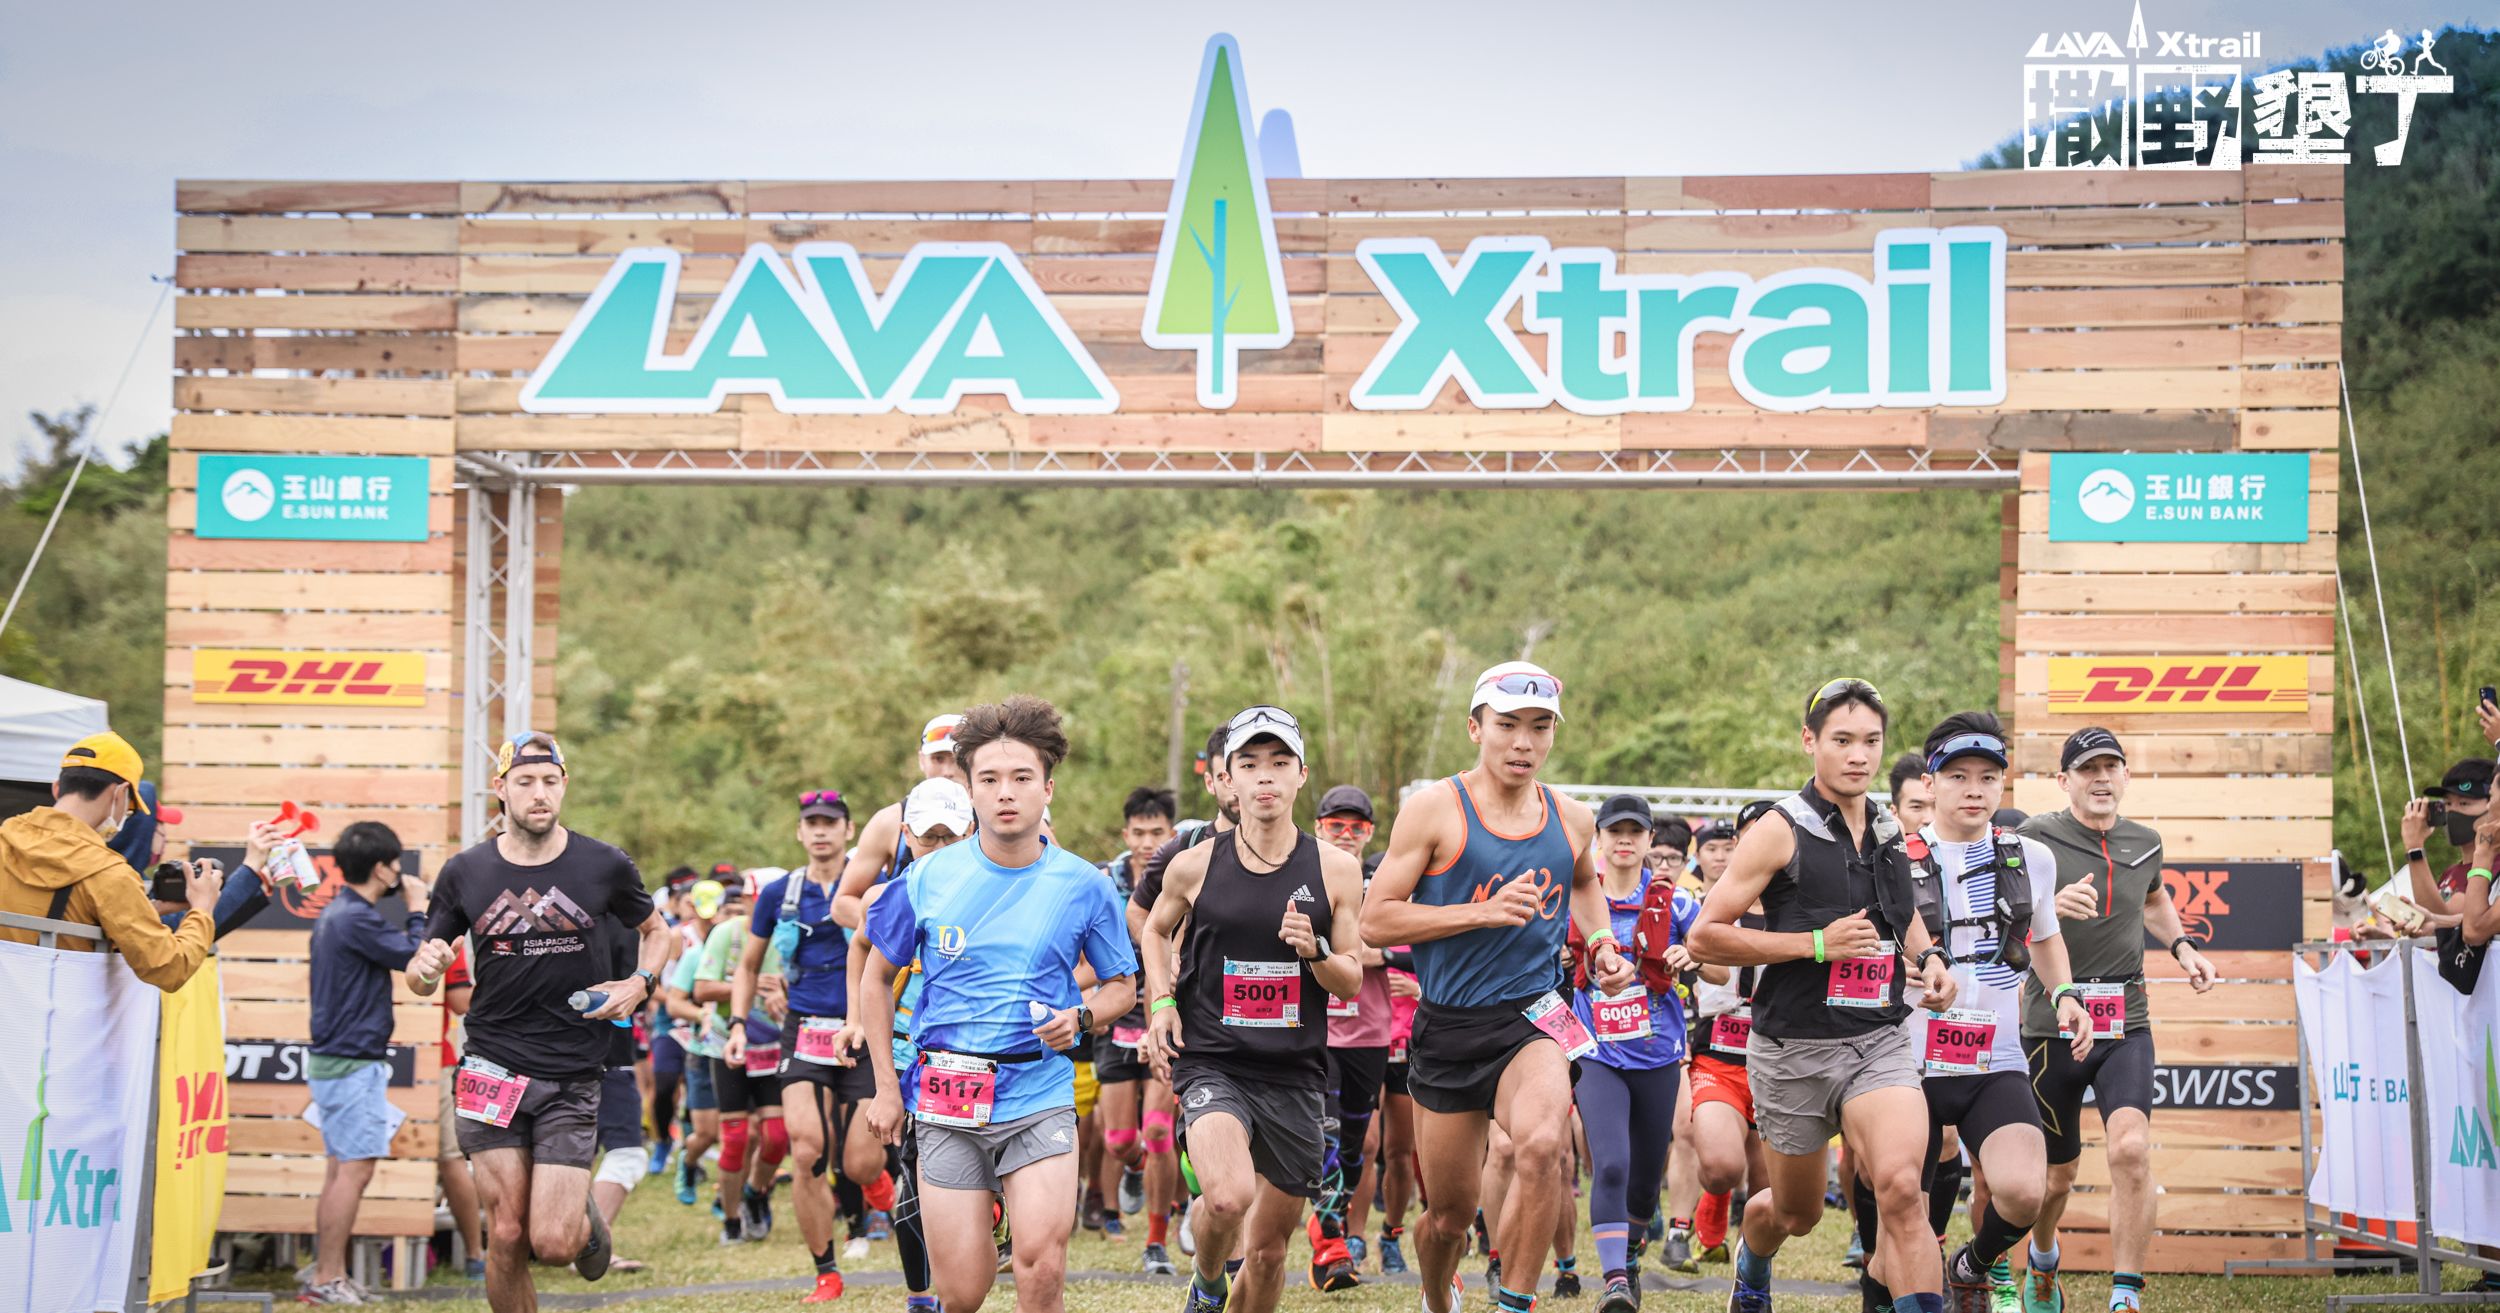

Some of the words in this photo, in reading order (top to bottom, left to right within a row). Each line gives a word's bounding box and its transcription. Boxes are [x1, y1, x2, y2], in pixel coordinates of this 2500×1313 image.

[533, 256, 1106, 400] LAVA
[1363, 240, 1994, 401] Xtrail
[282, 475, 392, 501] 玉山銀行
[2145, 474, 2265, 501] 玉山銀行
[282, 504, 336, 519] E.SUN
[340, 506, 390, 520] BANK
[2145, 506, 2203, 520] E.SUN
[2210, 506, 2264, 520] BANK
[225, 660, 393, 695] DHL
[2083, 666, 2273, 702] DHL
[2161, 869, 2230, 915] OX
[523, 936, 579, 948] ASIA-PACIFIC
[523, 943, 585, 956] CHAMPIONSHIP
[1839, 963, 1887, 980] 5160
[1233, 984, 1288, 1001] 5001
[1600, 1003, 1642, 1022] 6009
[1720, 1021, 1751, 1035] 503
[1936, 1028, 1987, 1047] 5004
[805, 1034, 832, 1045] 510
[460, 1077, 500, 1100] 5005
[929, 1076, 984, 1099] 5117
[2385, 1079, 2408, 1103] BA
